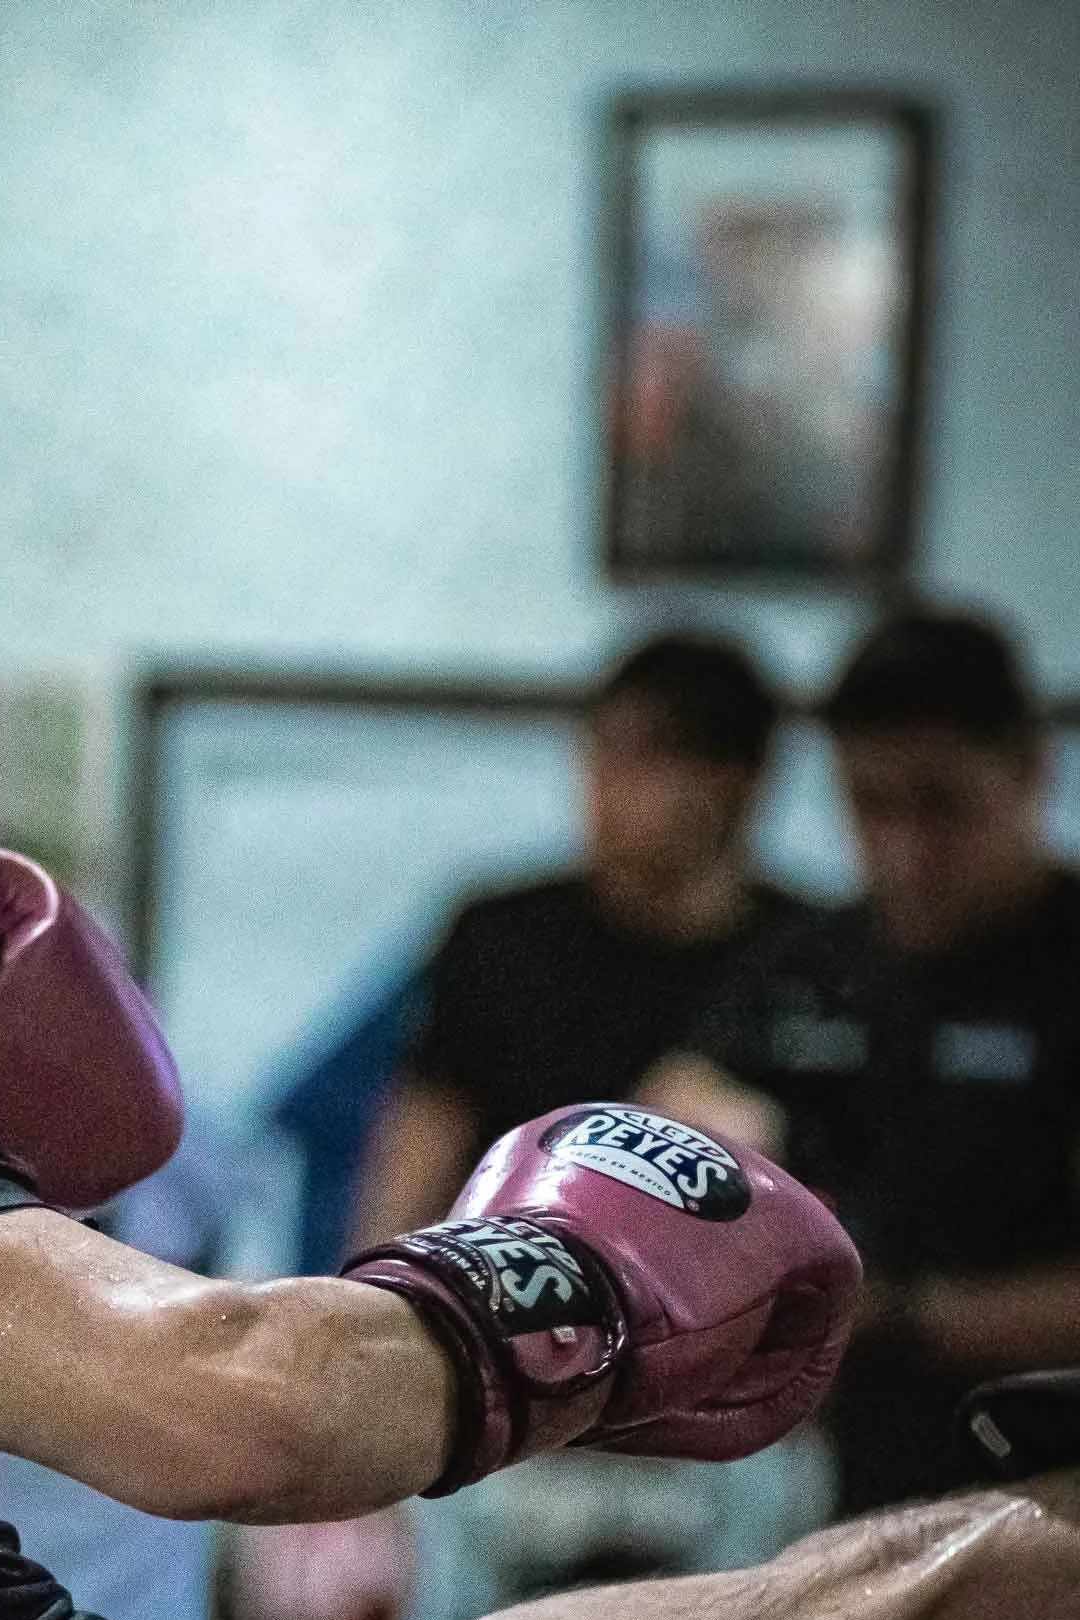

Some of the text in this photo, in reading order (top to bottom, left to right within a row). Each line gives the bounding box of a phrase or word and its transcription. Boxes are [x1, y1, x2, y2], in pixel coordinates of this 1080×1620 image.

[551, 1114, 728, 1198] REYES
[623, 1111, 724, 1158] CLETO
[410, 1217, 573, 1309] EYES
